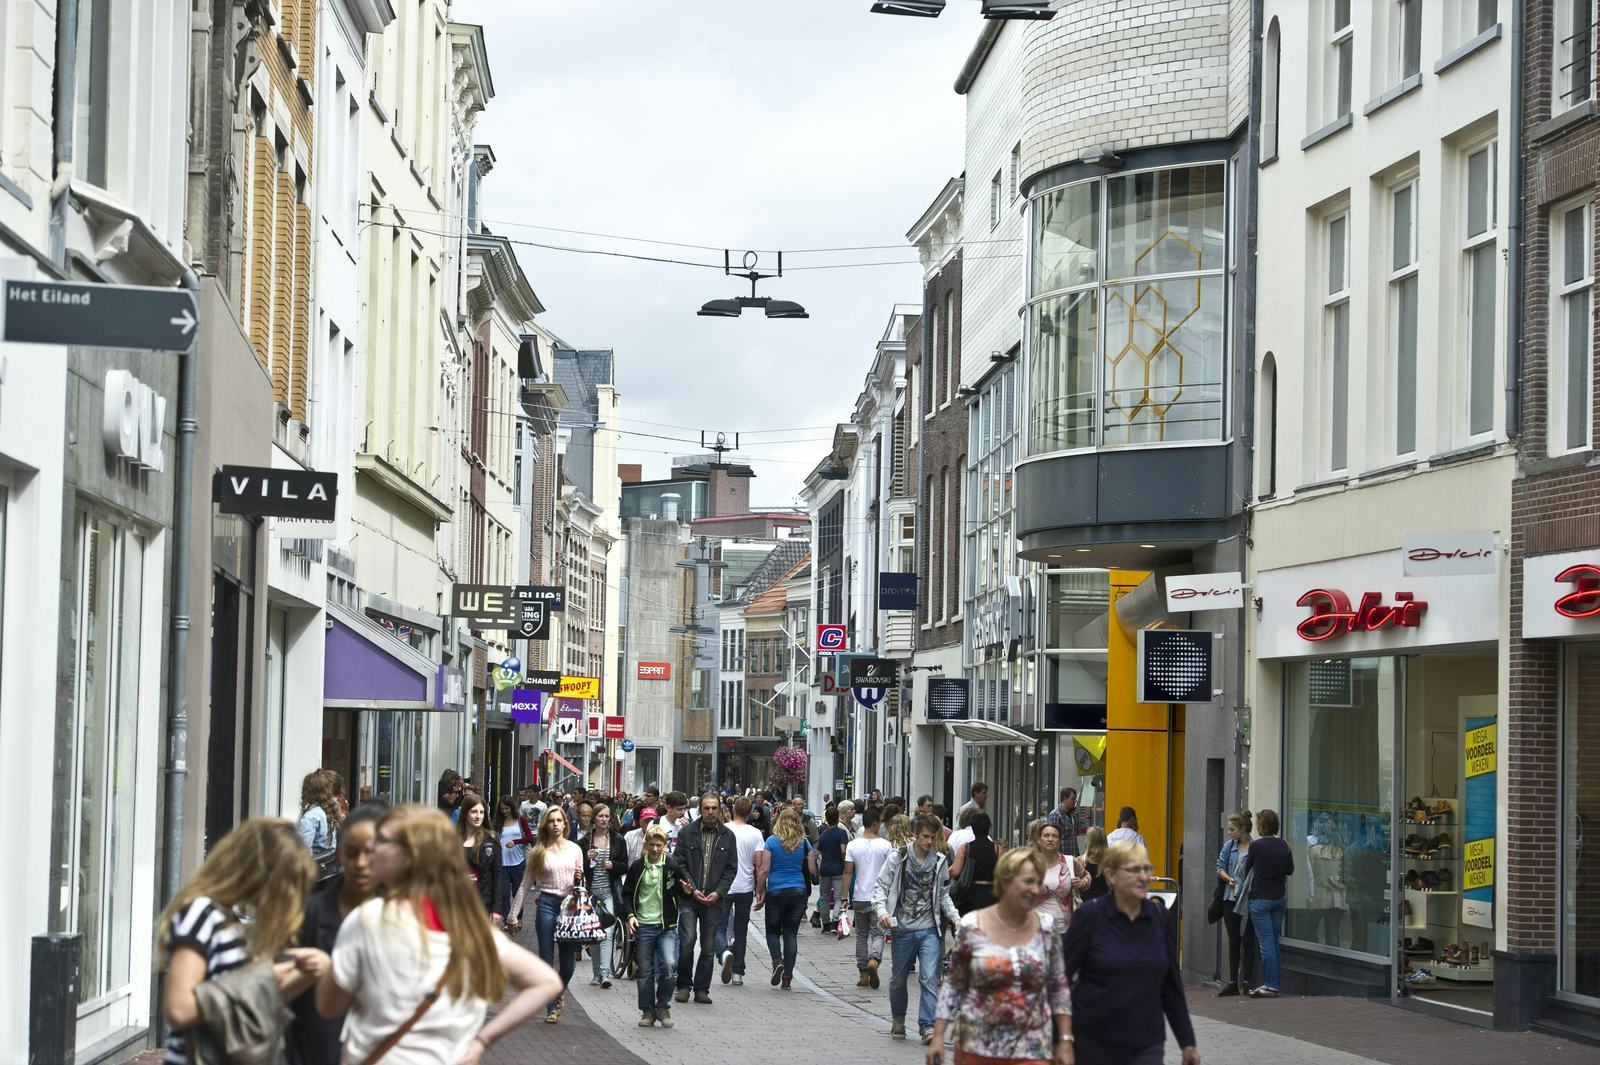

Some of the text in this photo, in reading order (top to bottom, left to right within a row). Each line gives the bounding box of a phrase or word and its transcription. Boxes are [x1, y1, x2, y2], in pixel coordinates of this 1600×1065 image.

[9, 287, 91, 306] Het Eiland
[230, 476, 328, 501] VILA
[459, 591, 504, 613] WE
[639, 666, 666, 675] ESPRIT
[855, 676, 891, 684] SWAROVSKI
[1472, 729, 1488, 744] MEGA
[1465, 741, 1495, 760] VOORDEEL
[1471, 757, 1489, 774] WEKEN
[1469, 842, 1485, 857] MEGA
[1464, 856, 1492, 872] VOORDEEL
[1469, 871, 1486, 887] WEKEN
